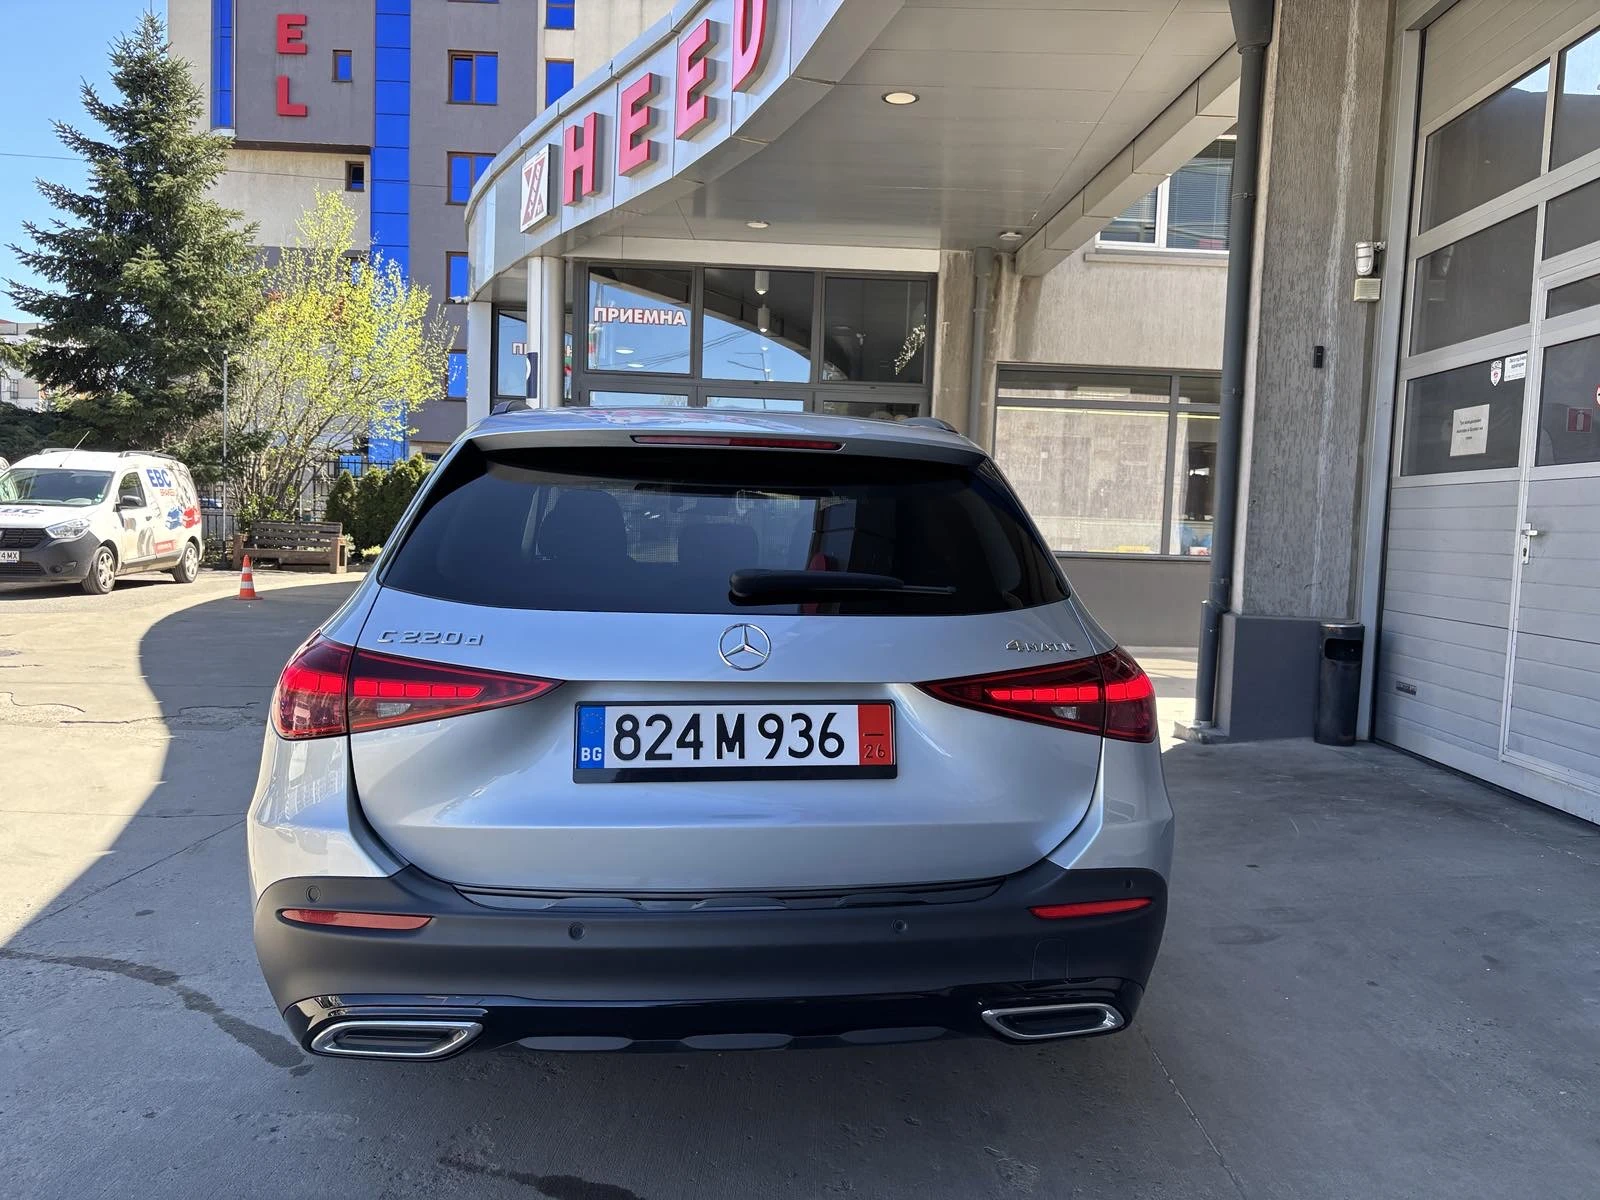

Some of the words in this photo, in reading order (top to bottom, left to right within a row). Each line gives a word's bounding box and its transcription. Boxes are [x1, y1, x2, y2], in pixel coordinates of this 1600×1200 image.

[593, 306, 688, 327] ПРИЕМНА
[146, 469, 172, 487] EBC
[377, 631, 398, 643] C
[400, 631, 463, 645] 220
[1005, 639, 1078, 652] 4MATIC
[581, 747, 602, 762] BG
[864, 744, 886, 759] 26
